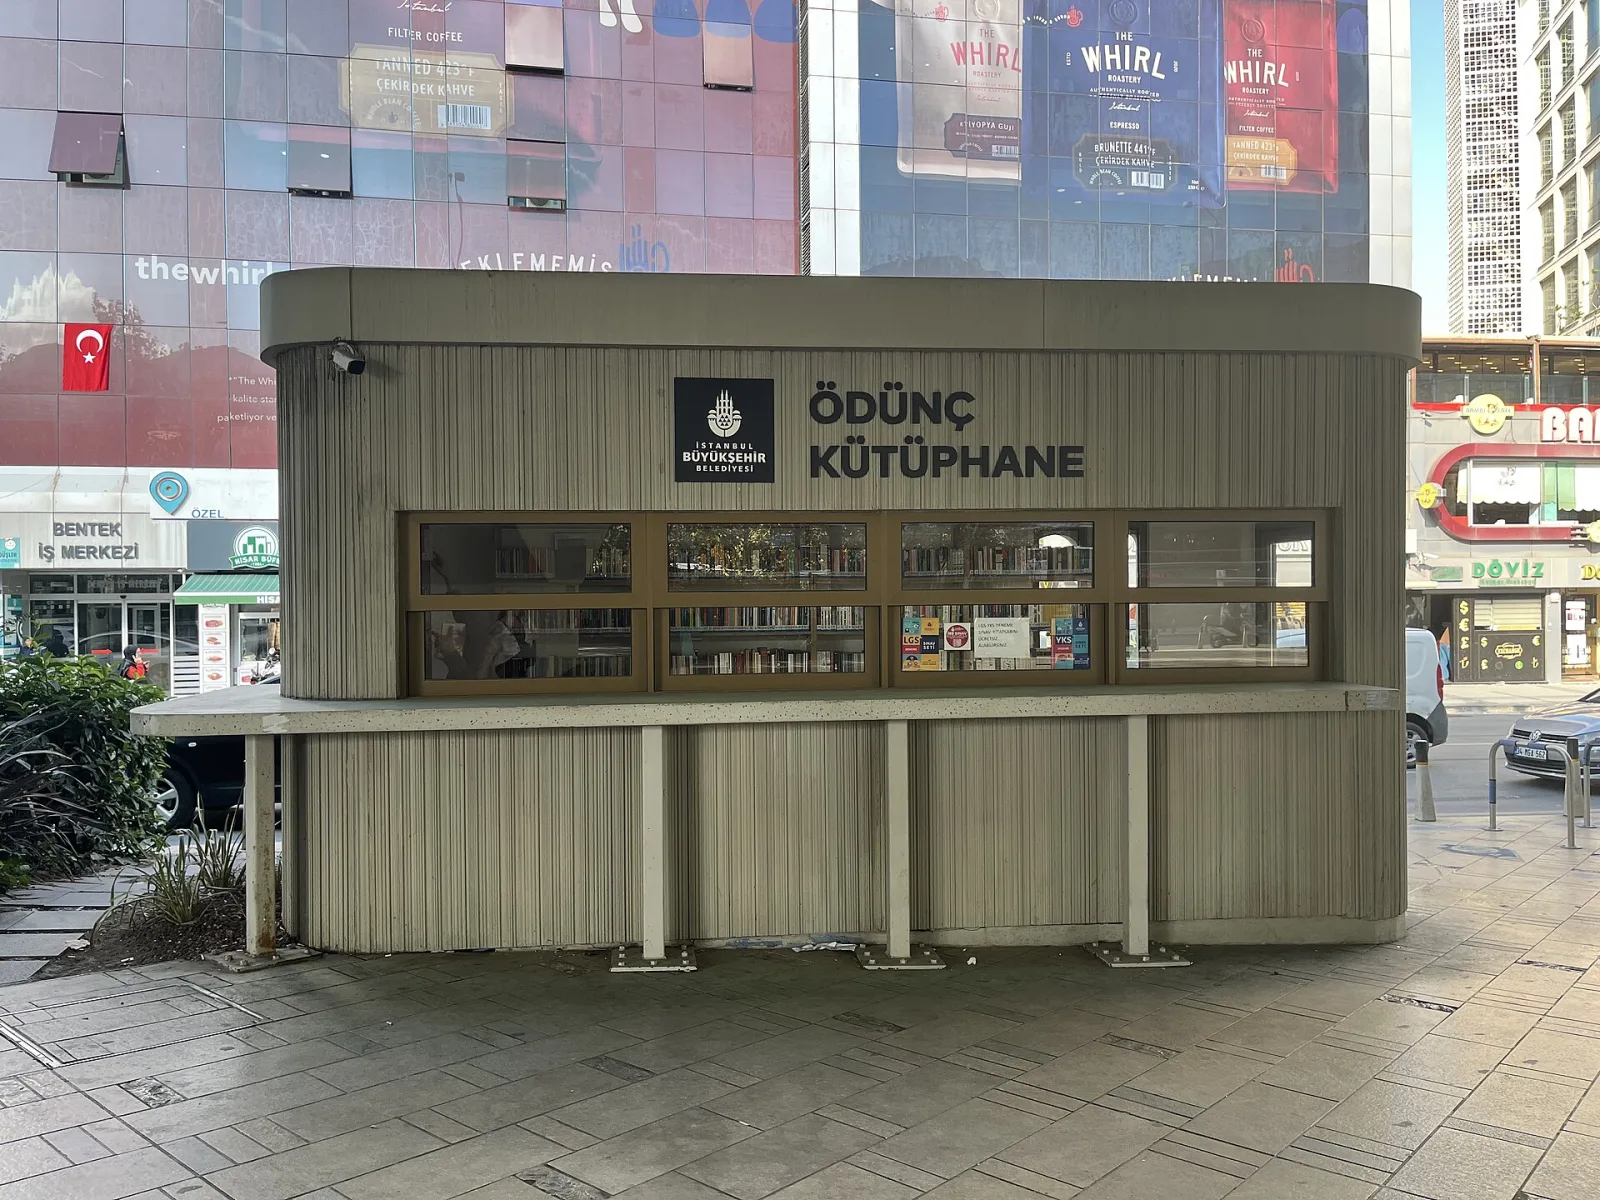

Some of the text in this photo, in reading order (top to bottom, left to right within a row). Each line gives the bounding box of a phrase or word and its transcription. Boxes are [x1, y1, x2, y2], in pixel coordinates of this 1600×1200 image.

[387, 27, 463, 42] FILTER COFFEE
[979, 28, 995, 39] THE
[1115, 31, 1133, 42] THE
[950, 41, 1022, 73] WHIRL
[1247, 48, 1263, 58] THE
[376, 56, 431, 75] TANNED
[1080, 44, 1166, 80] WHIRL
[1107, 74, 1142, 84] ROASTERY
[1224, 60, 1289, 88] WHIRL
[376, 77, 475, 97] ÇEKİRDEK KAHVE
[1241, 86, 1270, 95] ROASTERY
[1109, 121, 1140, 130] ESPRESSO
[1256, 126, 1274, 134] COFFEE
[1094, 141, 1133, 154] BRUNETTE
[1232, 141, 1259, 150] TANNED
[809, 380, 976, 431] ÖDÜNÇ
[217, 411, 264, 423] paketliyor
[696, 441, 754, 450] İSTANBUL
[682, 449, 766, 464] BÜYÜKŞEHİR
[809, 435, 1085, 478] KÜTÜPHANE
[696, 464, 754, 473] BELEDİYESİ
[191, 506, 225, 518] ÖZEL
[53, 521, 122, 537] BENTEK
[38, 542, 139, 563] İŞ MERKEZİ
[1472, 558, 1545, 579] DÖVİZ
[904, 636, 920, 644] LGS
[1055, 636, 1072, 644] YKS
